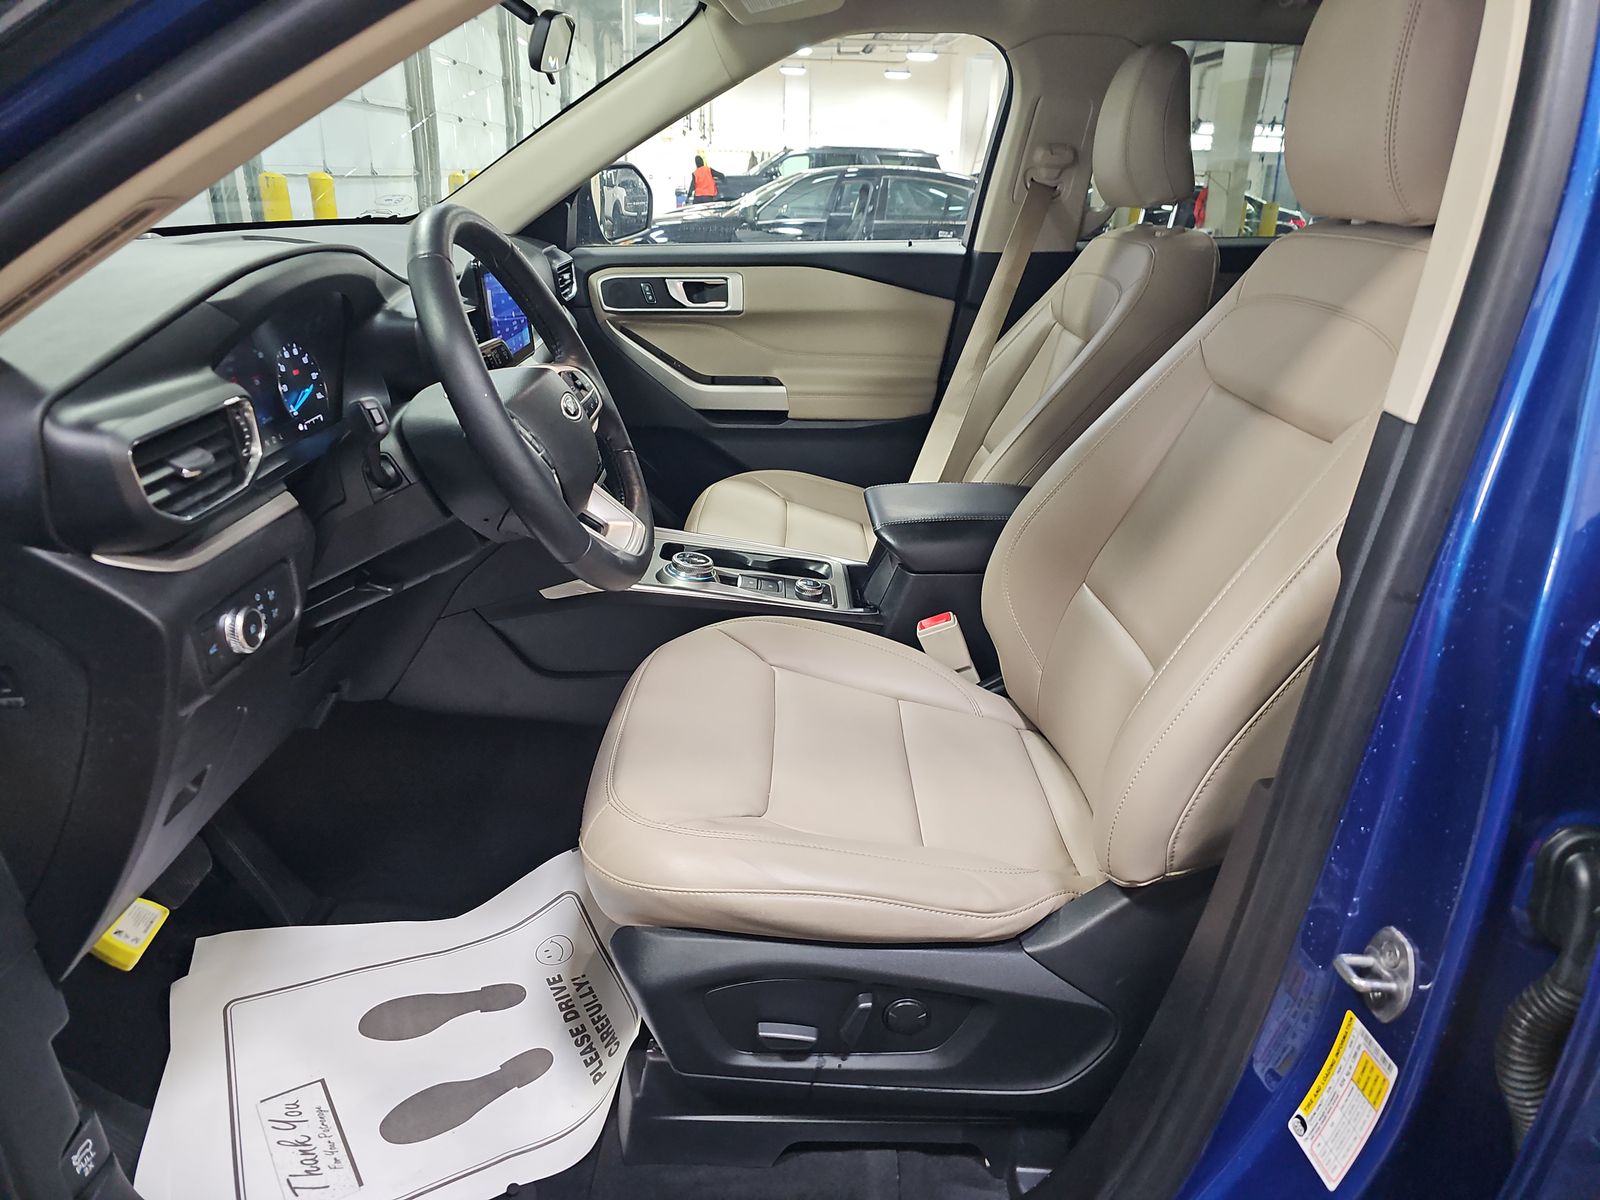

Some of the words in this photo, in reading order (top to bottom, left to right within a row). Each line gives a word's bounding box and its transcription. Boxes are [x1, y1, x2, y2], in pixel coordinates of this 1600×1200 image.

[546, 973, 581, 1023] DRIVE
[571, 974, 621, 1058] CAREFULLY!
[569, 1023, 607, 1085] PLEASE
[1313, 1084, 1322, 1097] AND
[1321, 1061, 1336, 1086] LOADING
[1333, 1016, 1354, 1059] INFORMATION
[268, 1099, 309, 1131] You
[276, 1134, 330, 1197] Thank
[323, 1140, 339, 1156] Your
[328, 1157, 344, 1170] For
